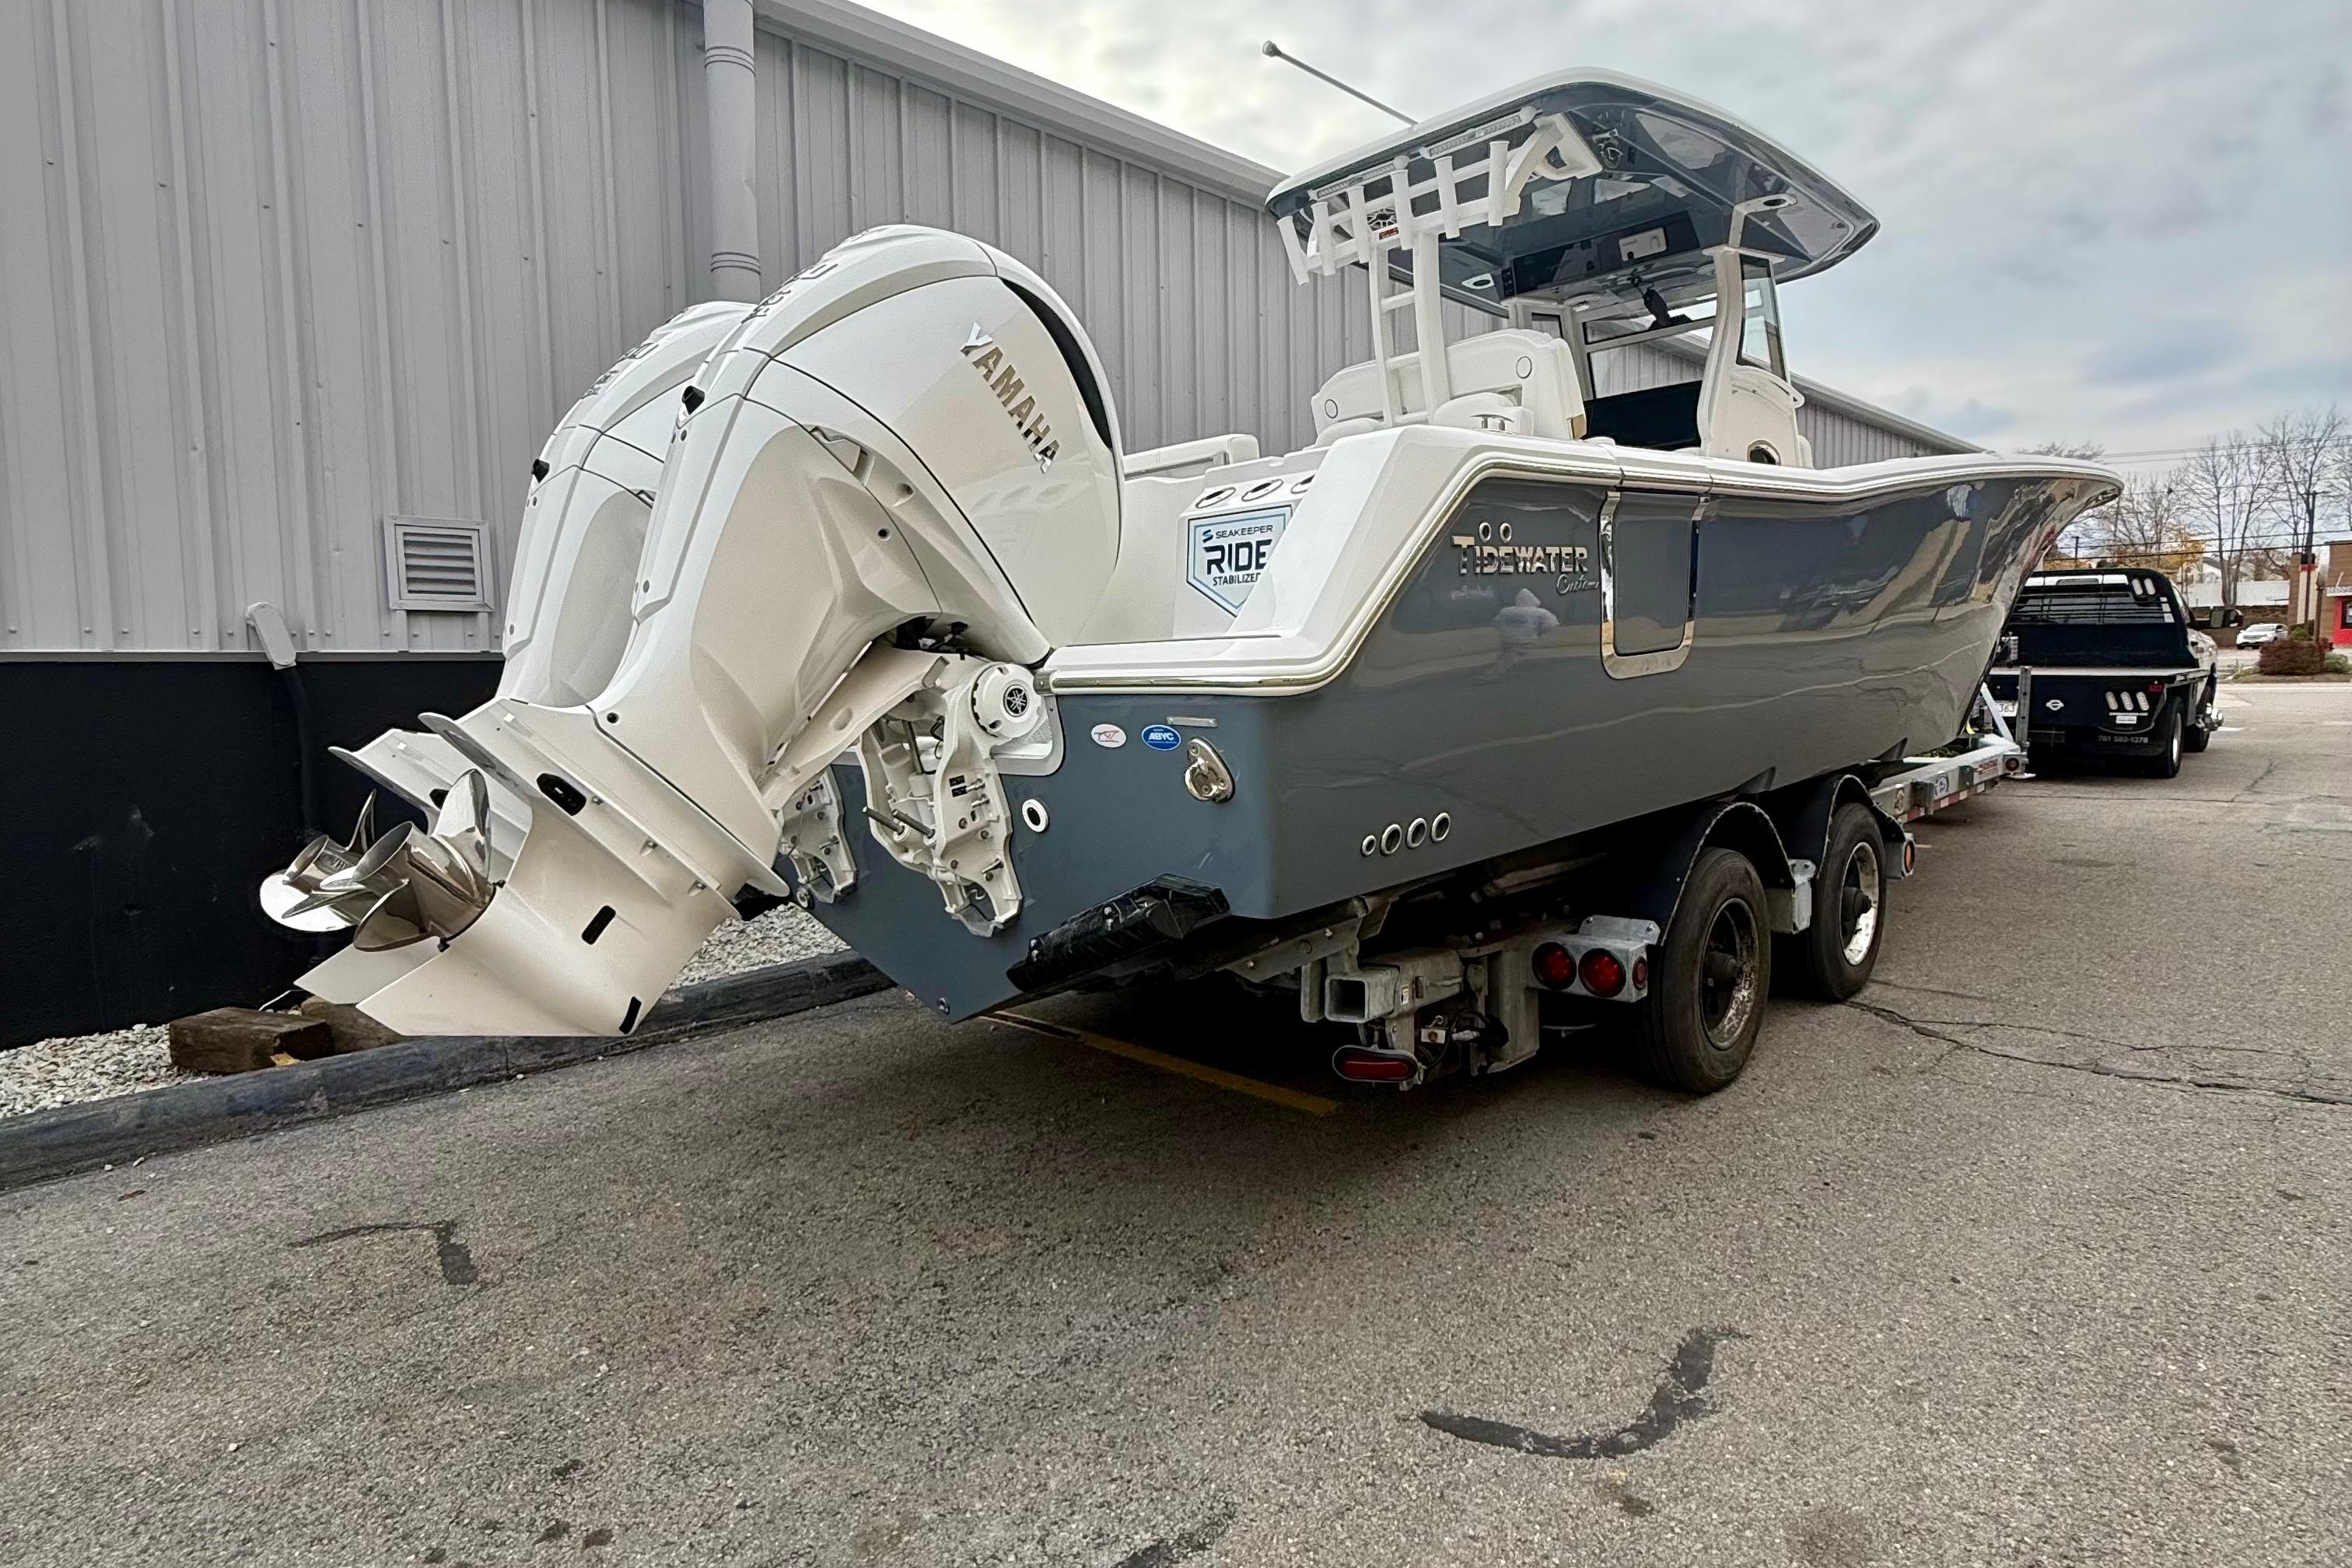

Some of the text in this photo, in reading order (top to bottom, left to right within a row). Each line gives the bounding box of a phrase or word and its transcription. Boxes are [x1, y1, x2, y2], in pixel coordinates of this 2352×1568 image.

[960, 322, 1060, 474] YAMAHA
[1215, 524, 1273, 539] SEAKEEPER
[1202, 539, 1272, 575] RIDE
[1451, 535, 1588, 574] TIDEWATER
[1147, 732, 1174, 740] ABYC
